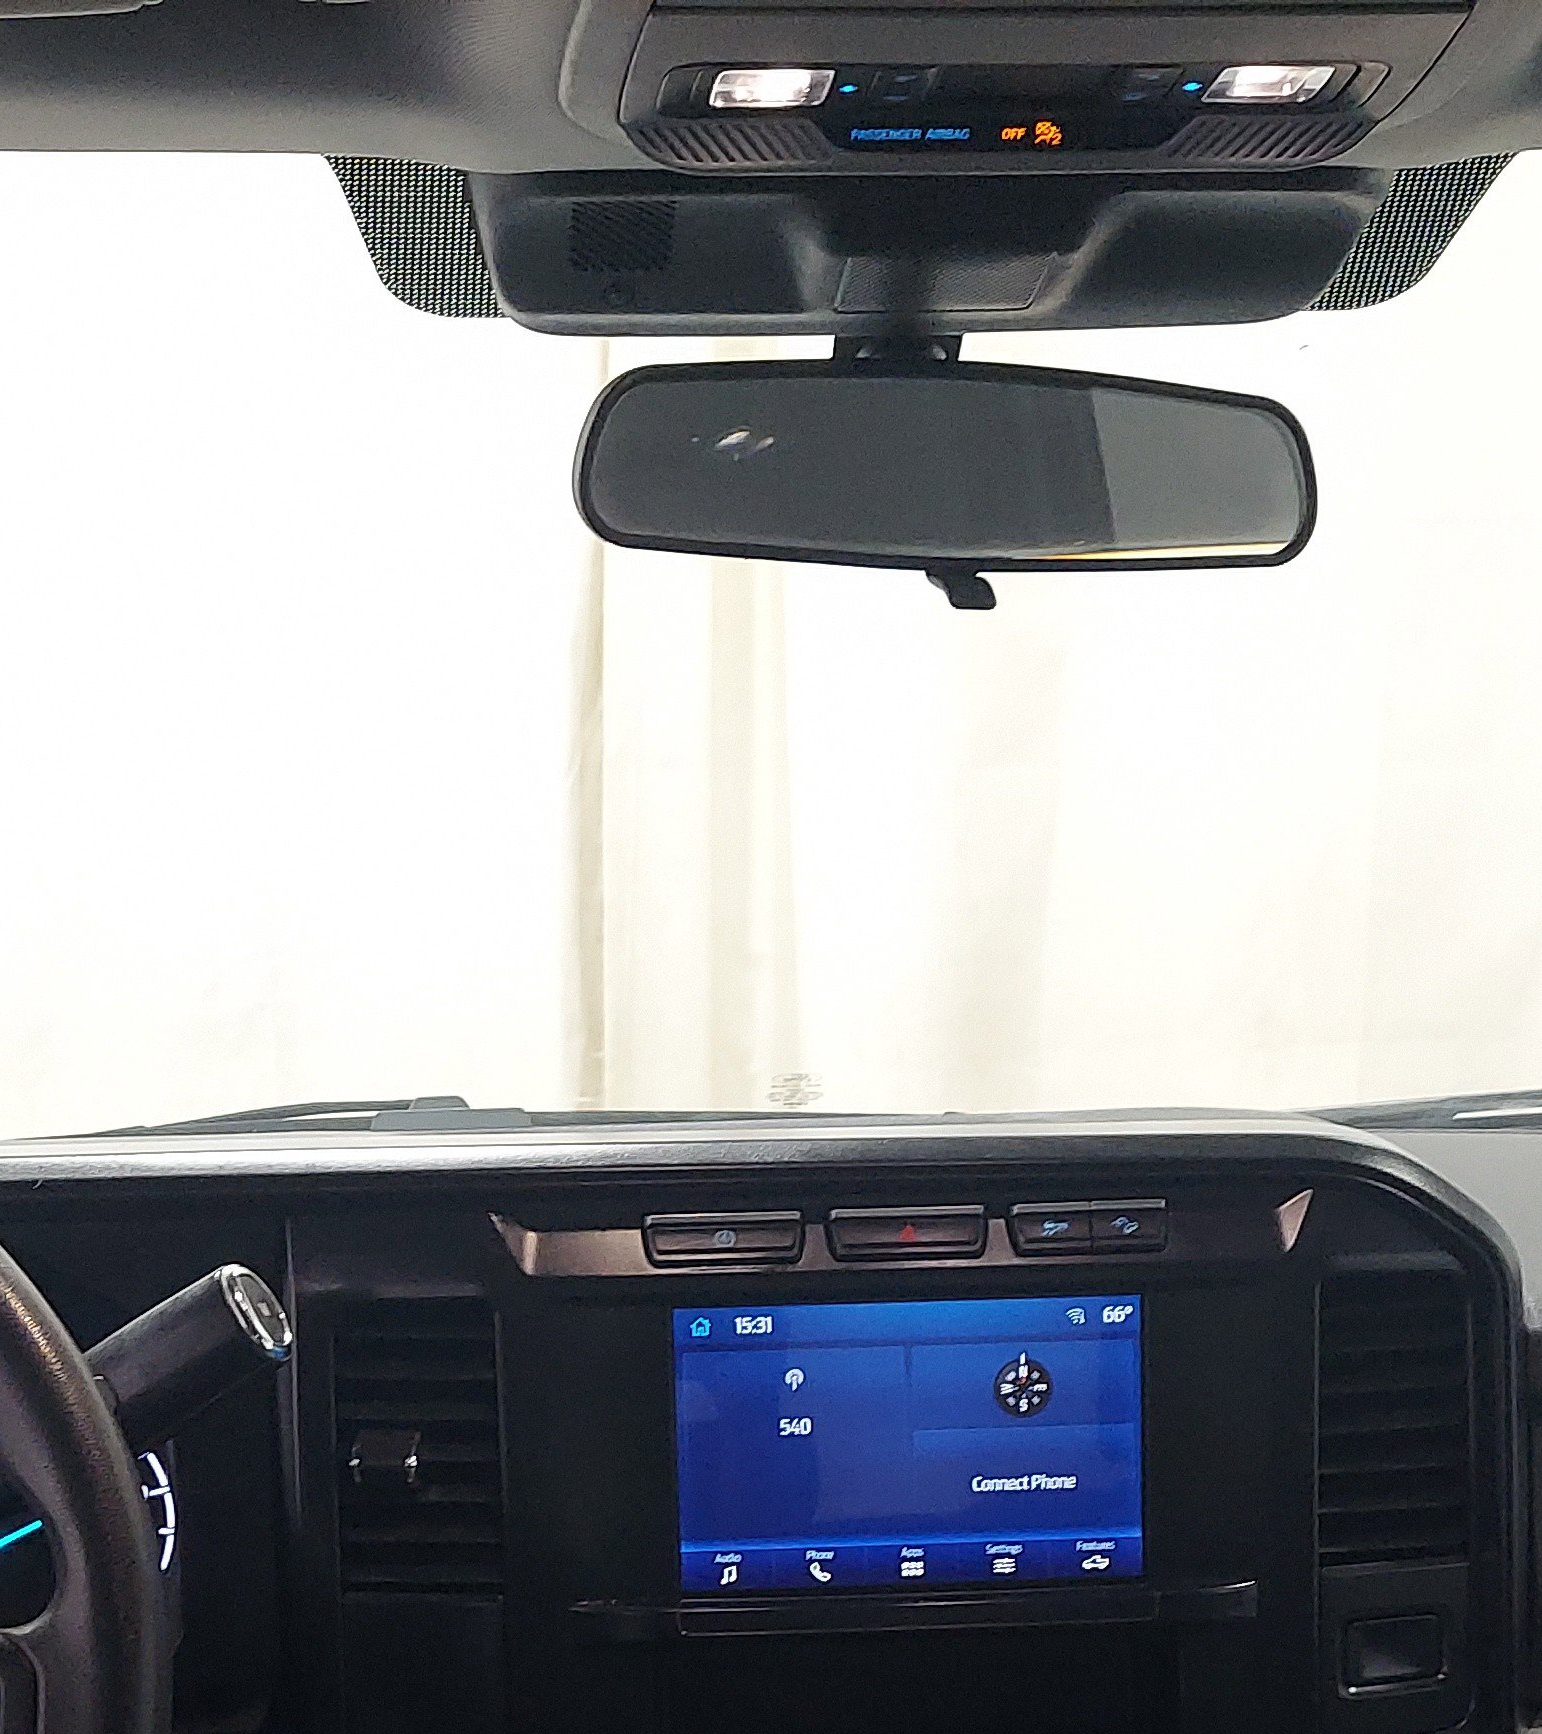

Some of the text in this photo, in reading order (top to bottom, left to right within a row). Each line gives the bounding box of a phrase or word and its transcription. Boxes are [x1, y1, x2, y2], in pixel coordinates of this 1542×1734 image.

[851, 127, 970, 140] PASSENGER AIRBAG
[1001, 127, 1026, 140] OFF
[779, 1418, 813, 1436] 540
[971, 1472, 1077, 1492] Connect Phone
[985, 1541, 1024, 1557] Settings
[1075, 1538, 1116, 1552] Features
[714, 1552, 742, 1564] Audio
